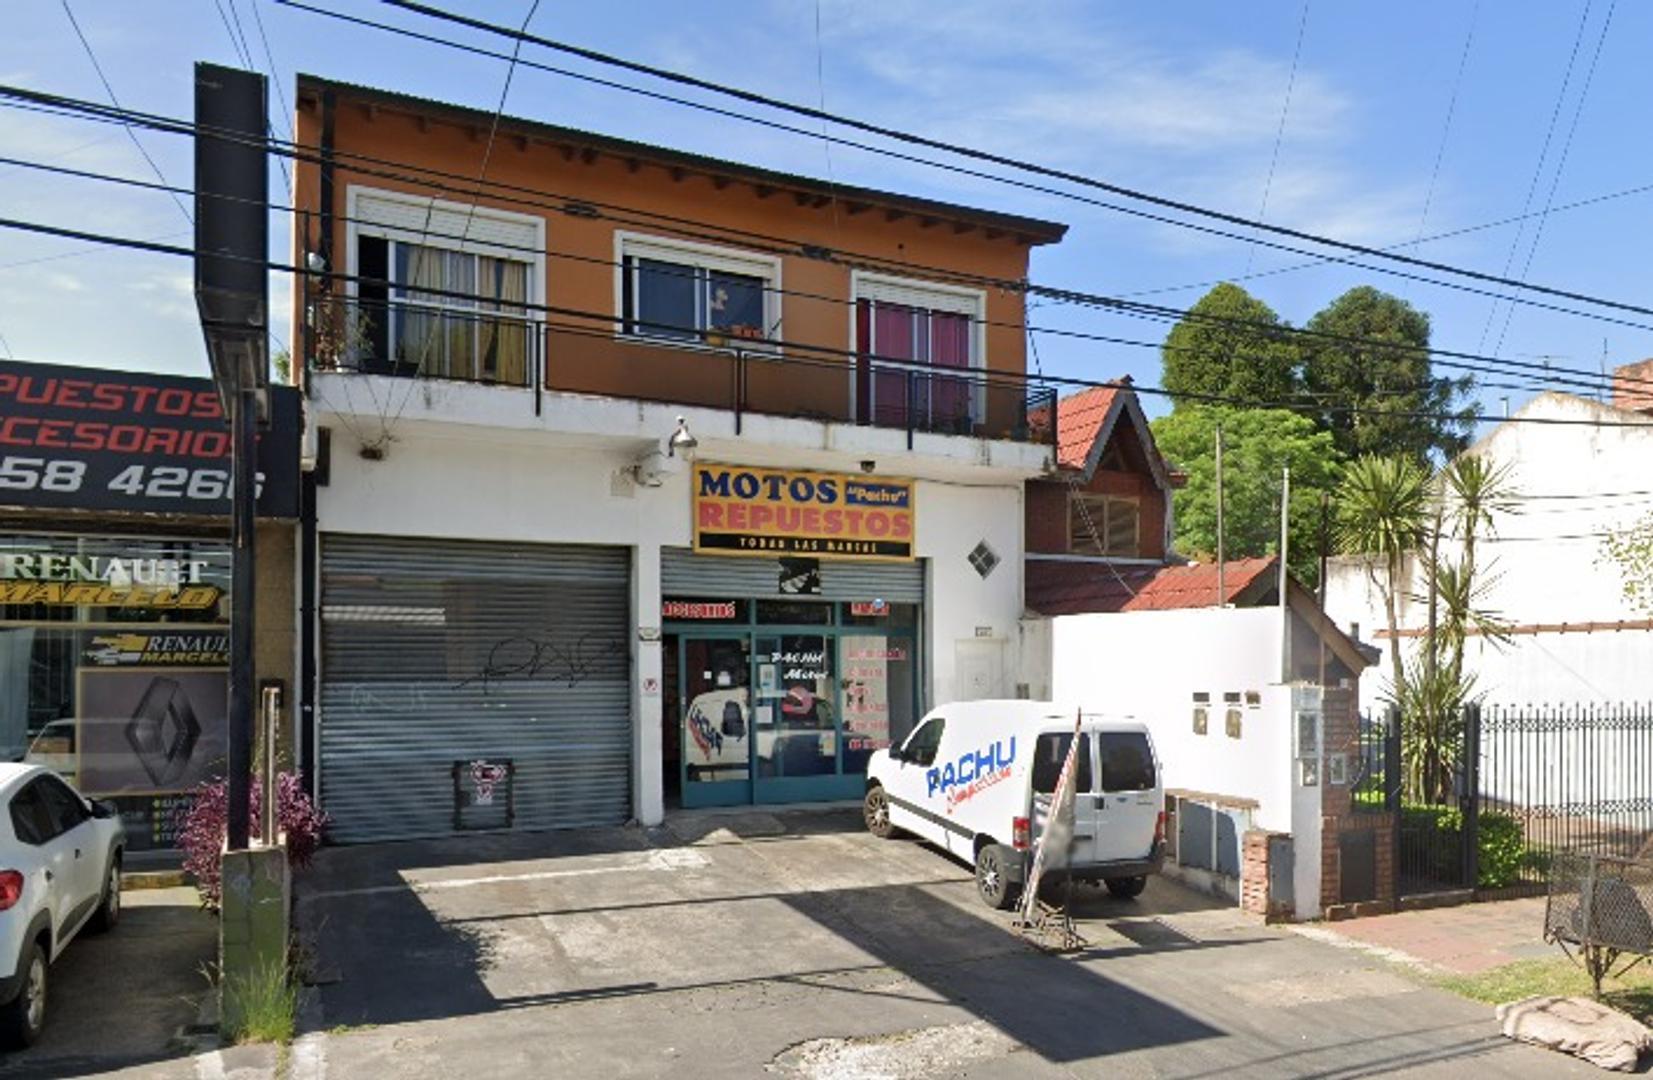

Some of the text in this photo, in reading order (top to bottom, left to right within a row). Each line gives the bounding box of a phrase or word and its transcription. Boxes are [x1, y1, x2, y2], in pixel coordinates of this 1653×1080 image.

[0, 414, 260, 458] CESORIO
[0, 455, 87, 493] 58
[698, 470, 838, 504] MOTOS
[699, 502, 911, 538] REPUESTOS
[2, 553, 208, 584] RENAULT
[147, 635, 229, 652] RENAUL
[926, 736, 1015, 798] PACHU
